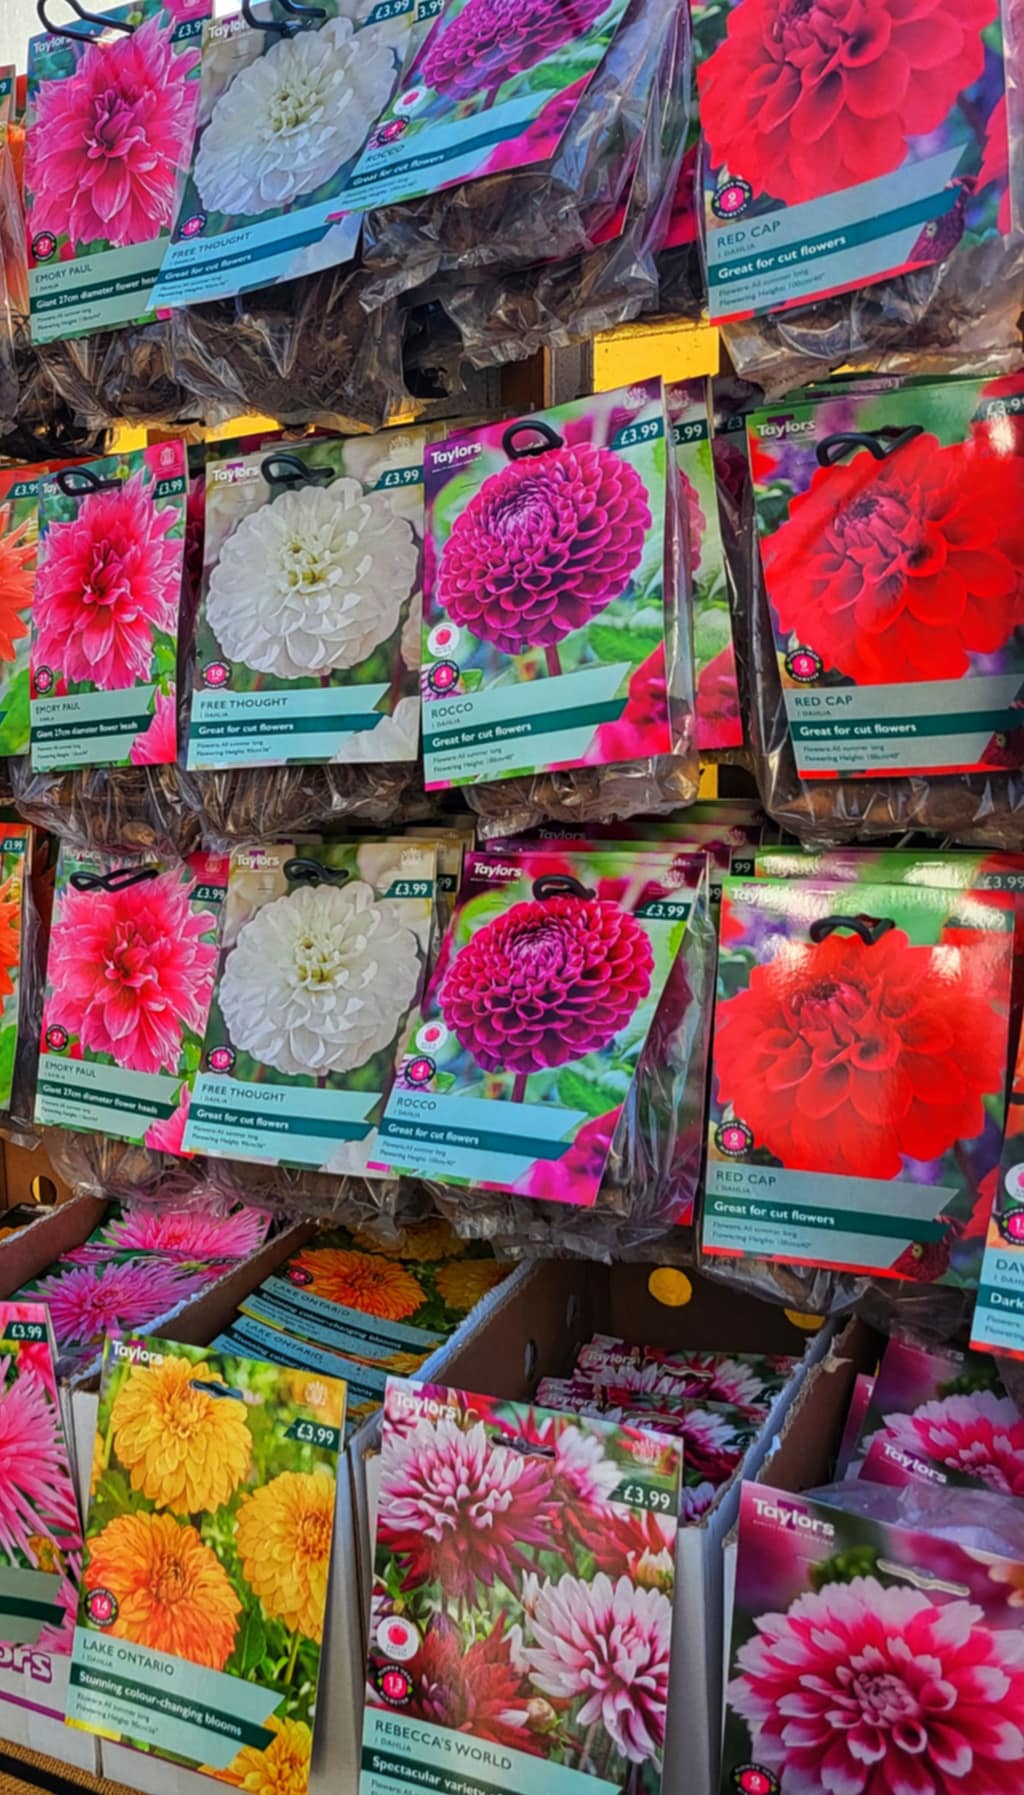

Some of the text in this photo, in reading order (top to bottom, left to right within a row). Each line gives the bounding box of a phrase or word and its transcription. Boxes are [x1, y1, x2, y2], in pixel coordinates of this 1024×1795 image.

[376, 1, 408, 18] £3.99
[717, 221, 780, 248] RED CAP
[172, 232, 250, 259] FREE THOUGHT
[719, 235, 846, 279] Great for cut flowers
[35, 264, 92, 283] EMORY PAUL
[164, 254, 252, 280] Great for cut flowers
[620, 424, 658, 446] £3.99
[757, 419, 815, 439] Taylors
[431, 442, 482, 466] Taylors
[213, 467, 259, 482] Taylors
[385, 471, 418, 486] £3.99
[160, 480, 183, 494] £3.99
[36, 702, 80, 714] EMORY PAUL
[201, 698, 287, 709] FREE THOUGHT
[795, 695, 852, 707] RED CAP
[432, 703, 473, 718] ROCCO
[199, 721, 294, 736] Great for cut flowers
[432, 722, 531, 748] Great for cut flowers
[799, 722, 917, 737] Great for cut flowers
[237, 853, 279, 869] Taylors
[474, 861, 522, 877] Taylors
[197, 886, 225, 900] £3.99
[396, 882, 428, 896] £3.99
[646, 904, 684, 917] £3.99
[45, 1062, 96, 1078] EMORY PAUL
[201, 1084, 285, 1102] FREE THOUGHT
[397, 1097, 436, 1110] ROCCO
[197, 1109, 289, 1131] Great for cut flowers
[388, 1122, 479, 1145] Great for cut flowers
[729, 1132, 738, 1142] 9
[716, 1170, 776, 1187] RED CAP
[714, 1200, 835, 1226] Great for cut flowers
[12, 1324, 42, 1339] £3.99
[111, 1340, 164, 1365] Taylors
[395, 1391, 456, 1418] Taylors
[297, 1422, 334, 1444] £3.99
[883, 1442, 947, 1484] Taylors
[624, 1485, 671, 1509] £3.99
[752, 1498, 834, 1537] Taylors
[96, 1600, 109, 1611] 14
[83, 1639, 175, 1677] LAKE ONTARIO
[389, 1678, 402, 1690] 13
[79, 1672, 121, 1696] Stunning
[125, 1685, 203, 1723] colour-changing
[205, 1713, 242, 1736] blooms
[376, 1720, 512, 1769] REBECCA'S WORLD
[372, 1756, 441, 1786] Spectacular
